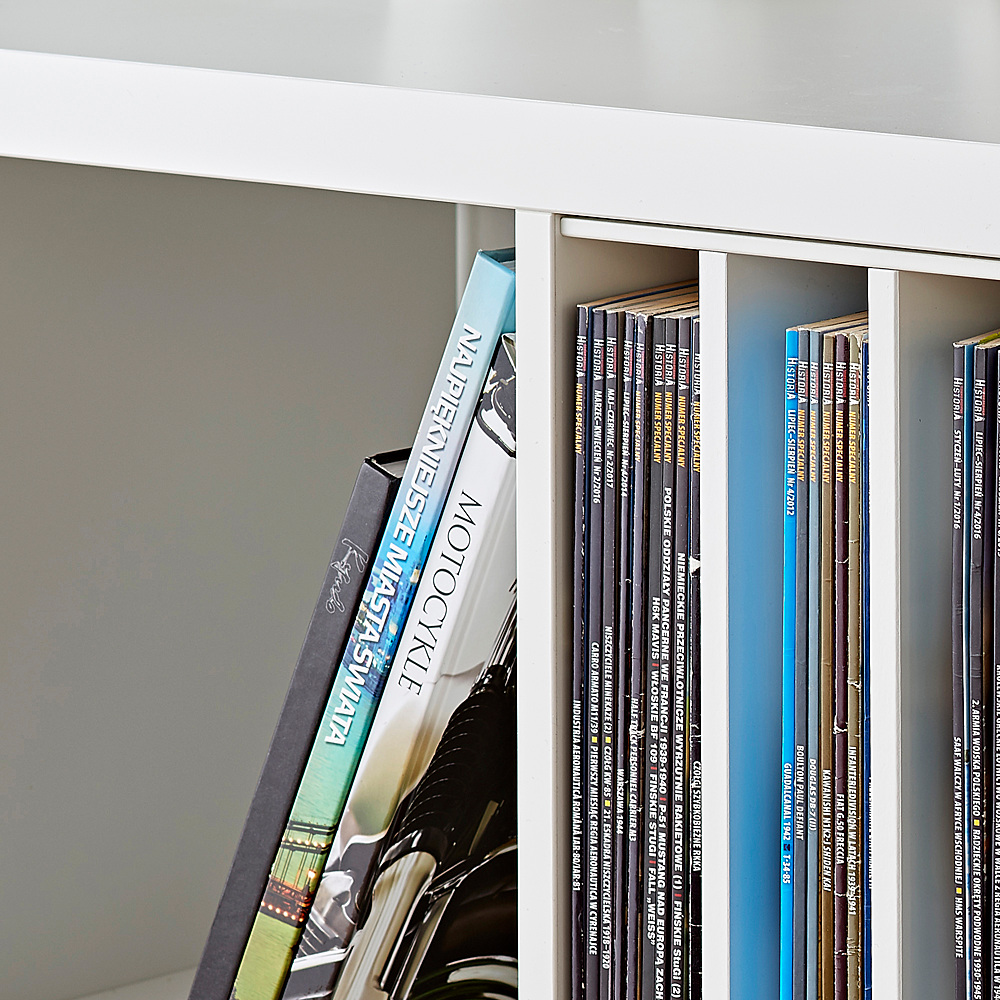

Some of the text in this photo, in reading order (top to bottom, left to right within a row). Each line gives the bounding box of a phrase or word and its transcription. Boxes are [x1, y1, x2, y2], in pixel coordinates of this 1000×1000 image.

[576, 335, 587, 377] HISTORIA
[654, 344, 665, 386] HISTORIA
[786, 357, 797, 400] HISTORIA
[654, 392, 662, 420] NUMER
[952, 377, 963, 420] HISTORIA
[402, 323, 482, 547] NAJPIĘKNIEJSZE
[575, 412, 583, 454] SPECJALNY
[663, 487, 671, 536] POLSKIE
[786, 488, 795, 515] 4/2012
[953, 501, 961, 529] 1/2016
[662, 539, 671, 596] ODDZIAŁY
[357, 542, 408, 644] MIASTA
[397, 488, 483, 697] MOTOCYKLE
[652, 597, 660, 620] H6K
[651, 624, 660, 660] MAVIS
[661, 599, 670, 661] PANCERNE
[604, 626, 612, 680] NISZCZYCIELE
[661, 663, 669, 680] WE
[604, 680, 612, 721] MINEKAZE
[650, 670, 659, 722] WŁOSKIE
[660, 684, 669, 733] FRANCJI
[972, 699, 980, 707] 2.
[603, 722, 612, 734] (2)
[650, 725, 658, 740] BF
[972, 708, 980, 736] ARMIA
[603, 746, 611, 771] CZOŁG
[629, 746, 638, 792] PERSONNEL
[650, 743, 658, 763] 109
[972, 737, 980, 770] WOJSKA
[603, 771, 611, 797] KW-85
[671, 552, 685, 998] NIEMIECKIE PRZECIWLOTNICZE WYRZUTNIE RAKIETOWE (1) FIŃSKIE StuGi (2)
[783, 762, 792, 820] GUADALCANAL
[796, 745, 804, 840] BOULTON PAUL DEFIANT
[822, 769, 831, 816] KAWANISHI
[954, 759, 962, 791] WALCZY
[588, 641, 599, 955] CARRO ARMATO M11/39 PIERWSZY MIESIĄC REGIA AERONAUTICA W CYRENAJCE
[616, 768, 624, 834] WARSZAWA 1944
[629, 793, 637, 828] CARRIER
[954, 791, 962, 800] W
[603, 809, 611, 822] 21.
[783, 821, 791, 840] 1942
[836, 794, 844, 864] FIAT G.50 FRECCIA
[954, 801, 962, 831] AFRYCE
[602, 823, 611, 860] ESKADRA
[629, 829, 636, 842] M3
[648, 822, 656, 856] STUGI
[972, 829, 981, 876] RADZIECKIE
[657, 832, 666, 888] MUSTANG
[692, 850, 701, 872] RKKA
[823, 846, 831, 876] SHIDEN
[954, 832, 963, 884] WSCHODNIEJ
[602, 861, 611, 924] NISZCZYCIELSKA
[648, 867, 656, 895] FALL
[823, 876, 831, 892] KAI
[972, 877, 981, 909] OKRĘTY
[657, 891, 665, 916] NAD
[955, 897, 963, 915] HMS
[655, 919, 664, 965] EUROPĄ
[955, 916, 963, 958] WARSPITE
[973, 910, 981, 957] PODWODNE
